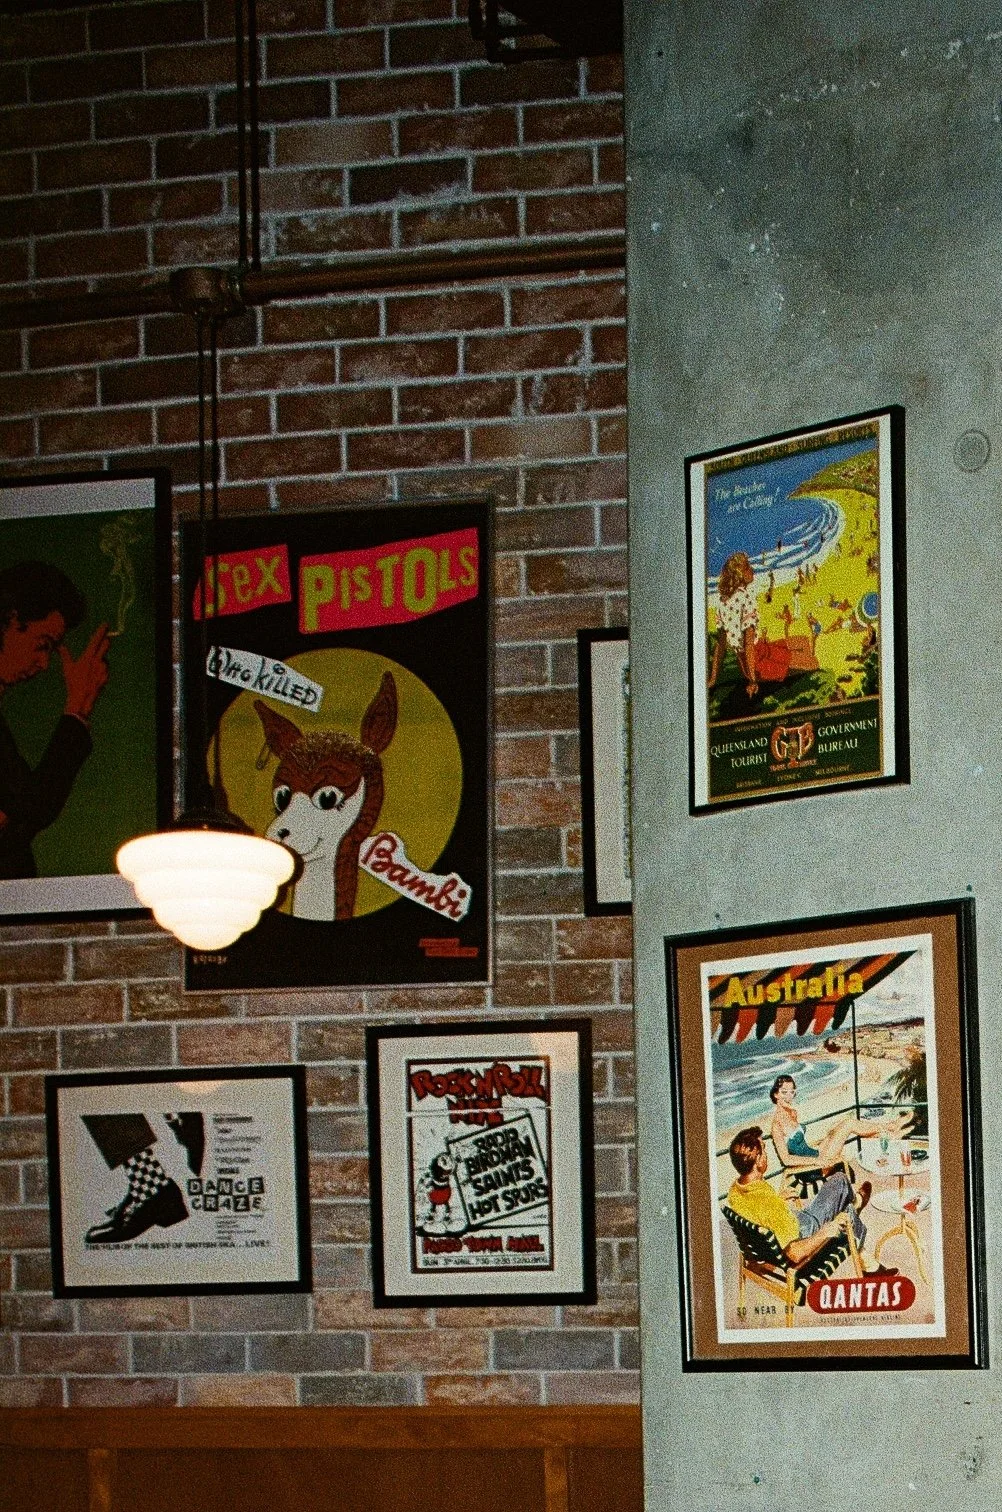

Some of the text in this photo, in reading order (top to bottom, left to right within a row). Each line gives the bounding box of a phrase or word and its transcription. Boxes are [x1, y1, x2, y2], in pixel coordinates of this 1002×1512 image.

[710, 736, 769, 758] QUEENSLAND
[818, 717, 878, 738] GOVERNMENT
[731, 753, 768, 768] TOURIST
[818, 738, 859, 754] BUREAU
[362, 834, 467, 918] Bambi
[723, 968, 864, 1008] Australia
[189, 1177, 264, 1195] DANCE
[472, 1158, 535, 1197] SAINTS
[191, 1195, 263, 1212] CRAZE
[468, 1177, 548, 1221] HOT SPURS
[754, 1305, 777, 1315] NEAR
[819, 1281, 902, 1309] QANTAS
